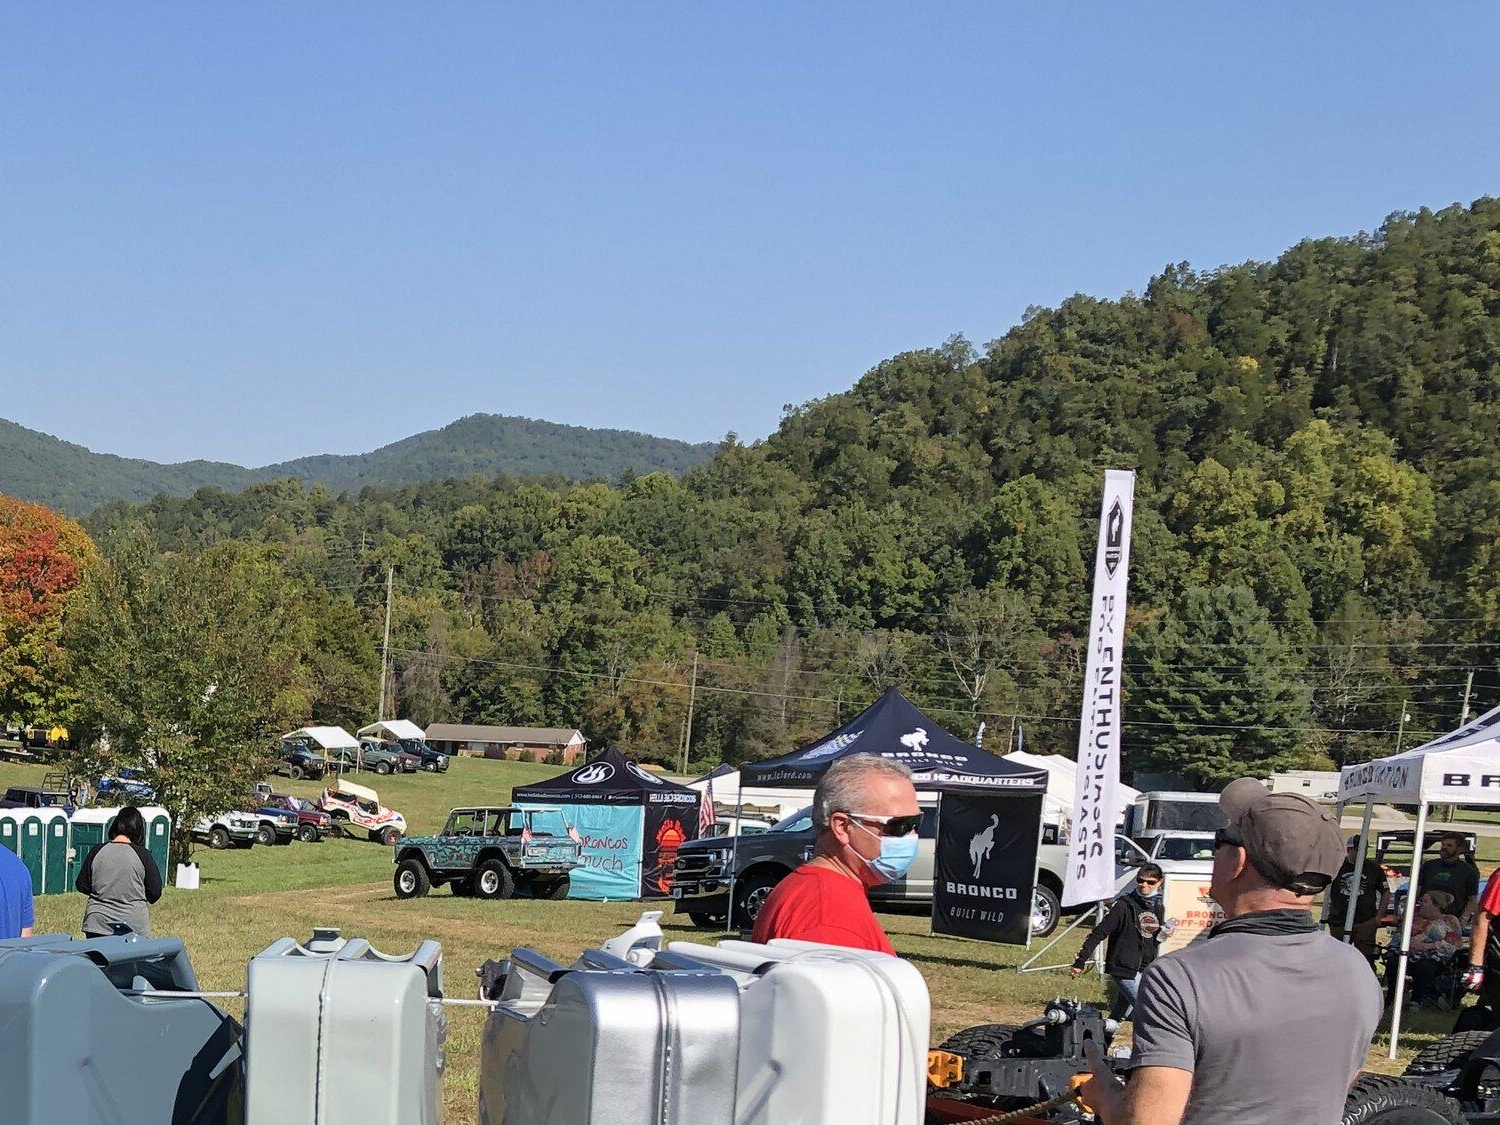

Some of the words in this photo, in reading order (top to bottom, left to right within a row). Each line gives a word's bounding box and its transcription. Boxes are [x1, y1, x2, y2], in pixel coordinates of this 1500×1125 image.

[931, 773, 1034, 786] HEADQUARTERS
[946, 881, 1017, 900] BRONCO
[950, 906, 976, 920] BUILT
[980, 910, 1004, 923] WILD
[1174, 919, 1225, 928] OFF-ROA
